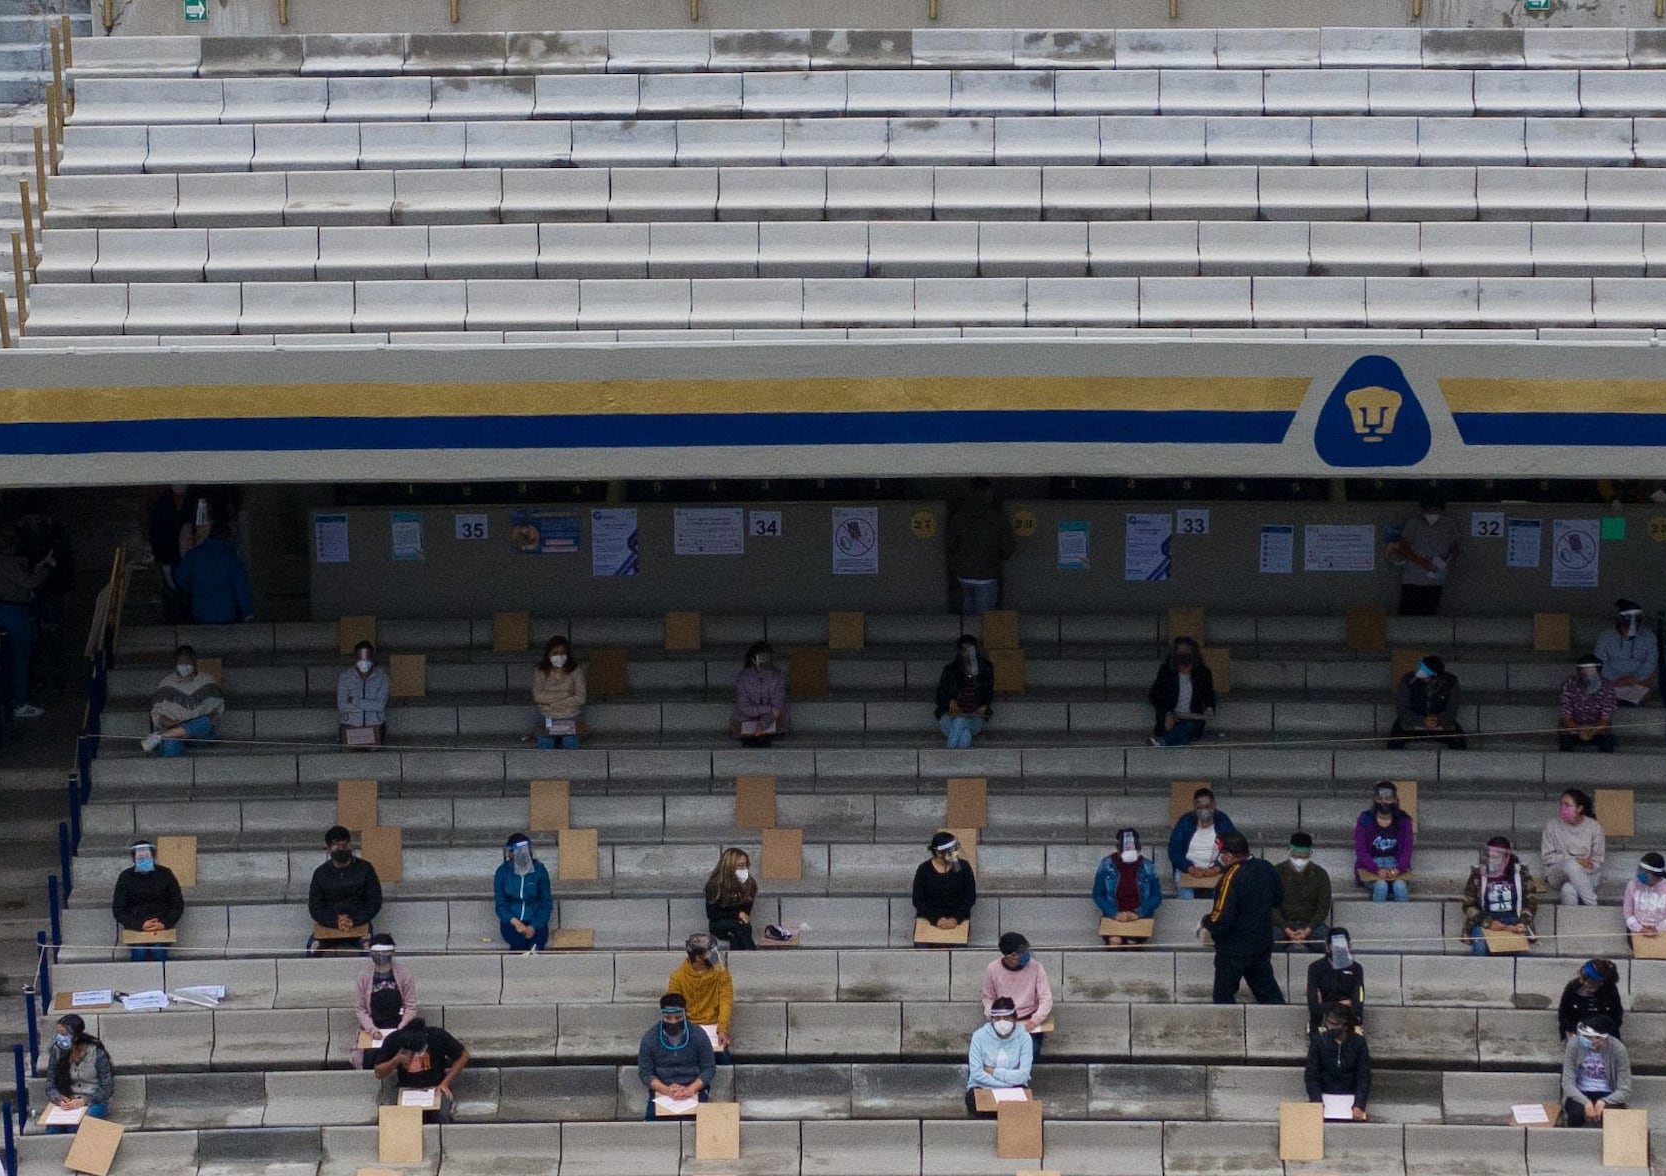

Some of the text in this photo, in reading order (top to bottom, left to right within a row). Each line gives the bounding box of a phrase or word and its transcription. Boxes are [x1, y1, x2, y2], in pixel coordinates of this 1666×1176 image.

[462, 522, 484, 538] 35
[756, 520, 777, 535] 34
[1183, 518, 1205, 533] 33
[1478, 521, 1500, 536] 32
